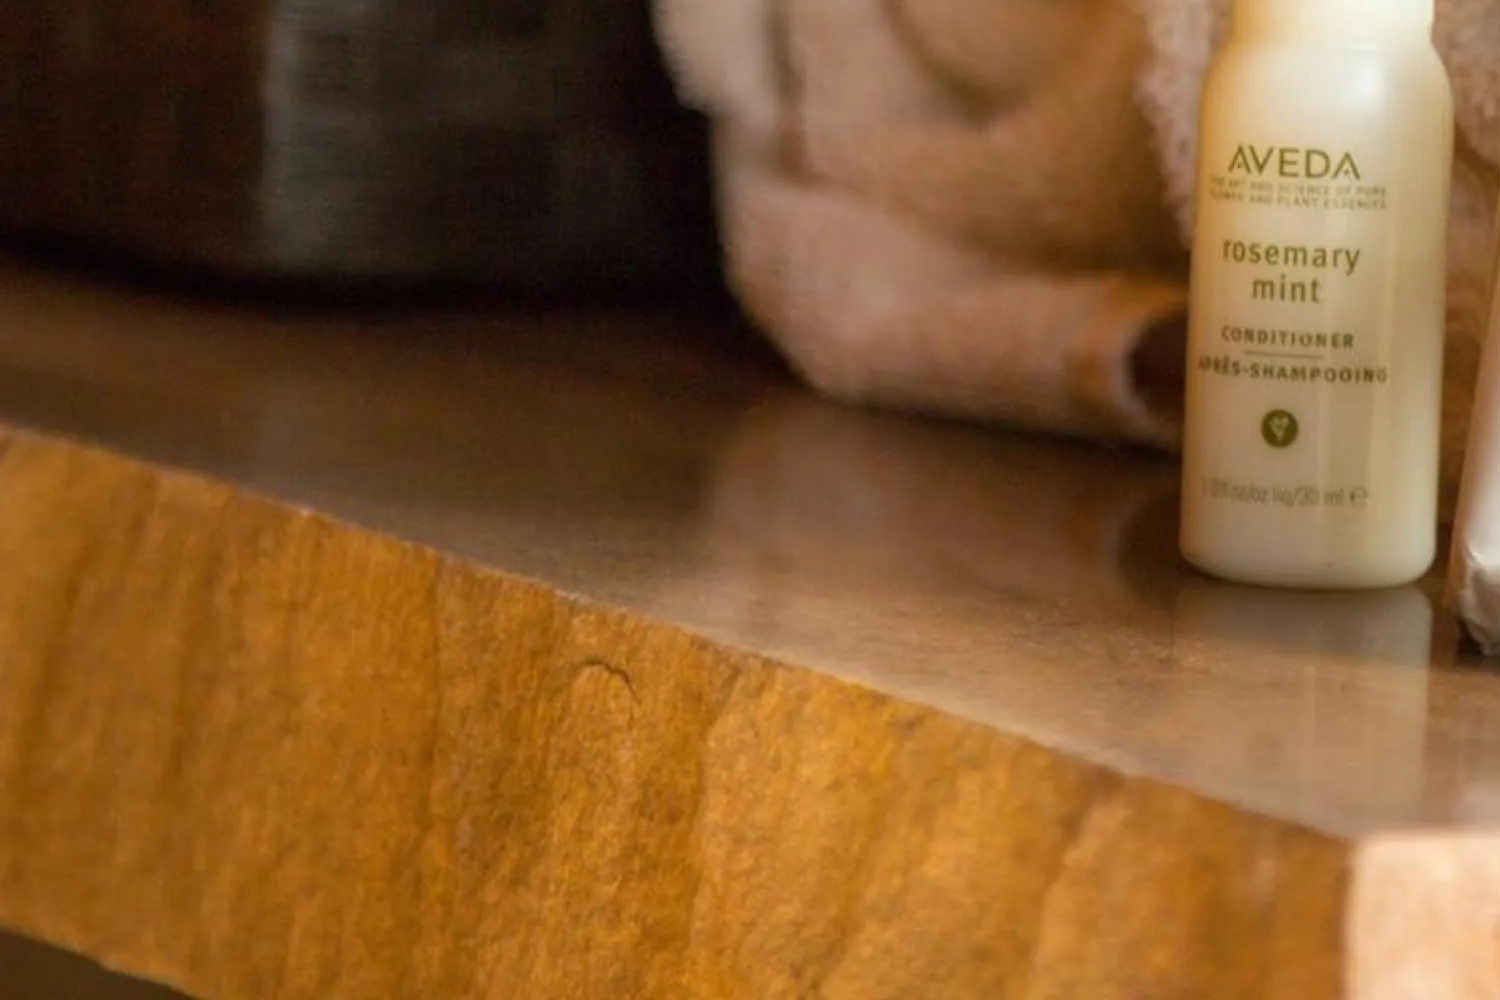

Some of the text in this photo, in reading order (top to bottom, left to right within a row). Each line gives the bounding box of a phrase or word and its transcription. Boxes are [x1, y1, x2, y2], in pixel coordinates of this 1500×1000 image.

[1227, 144, 1361, 181] AVEDA
[1222, 239, 1361, 276] rosemary
[1252, 273, 1322, 304] mint
[1221, 324, 1355, 349] CONDITIONER
